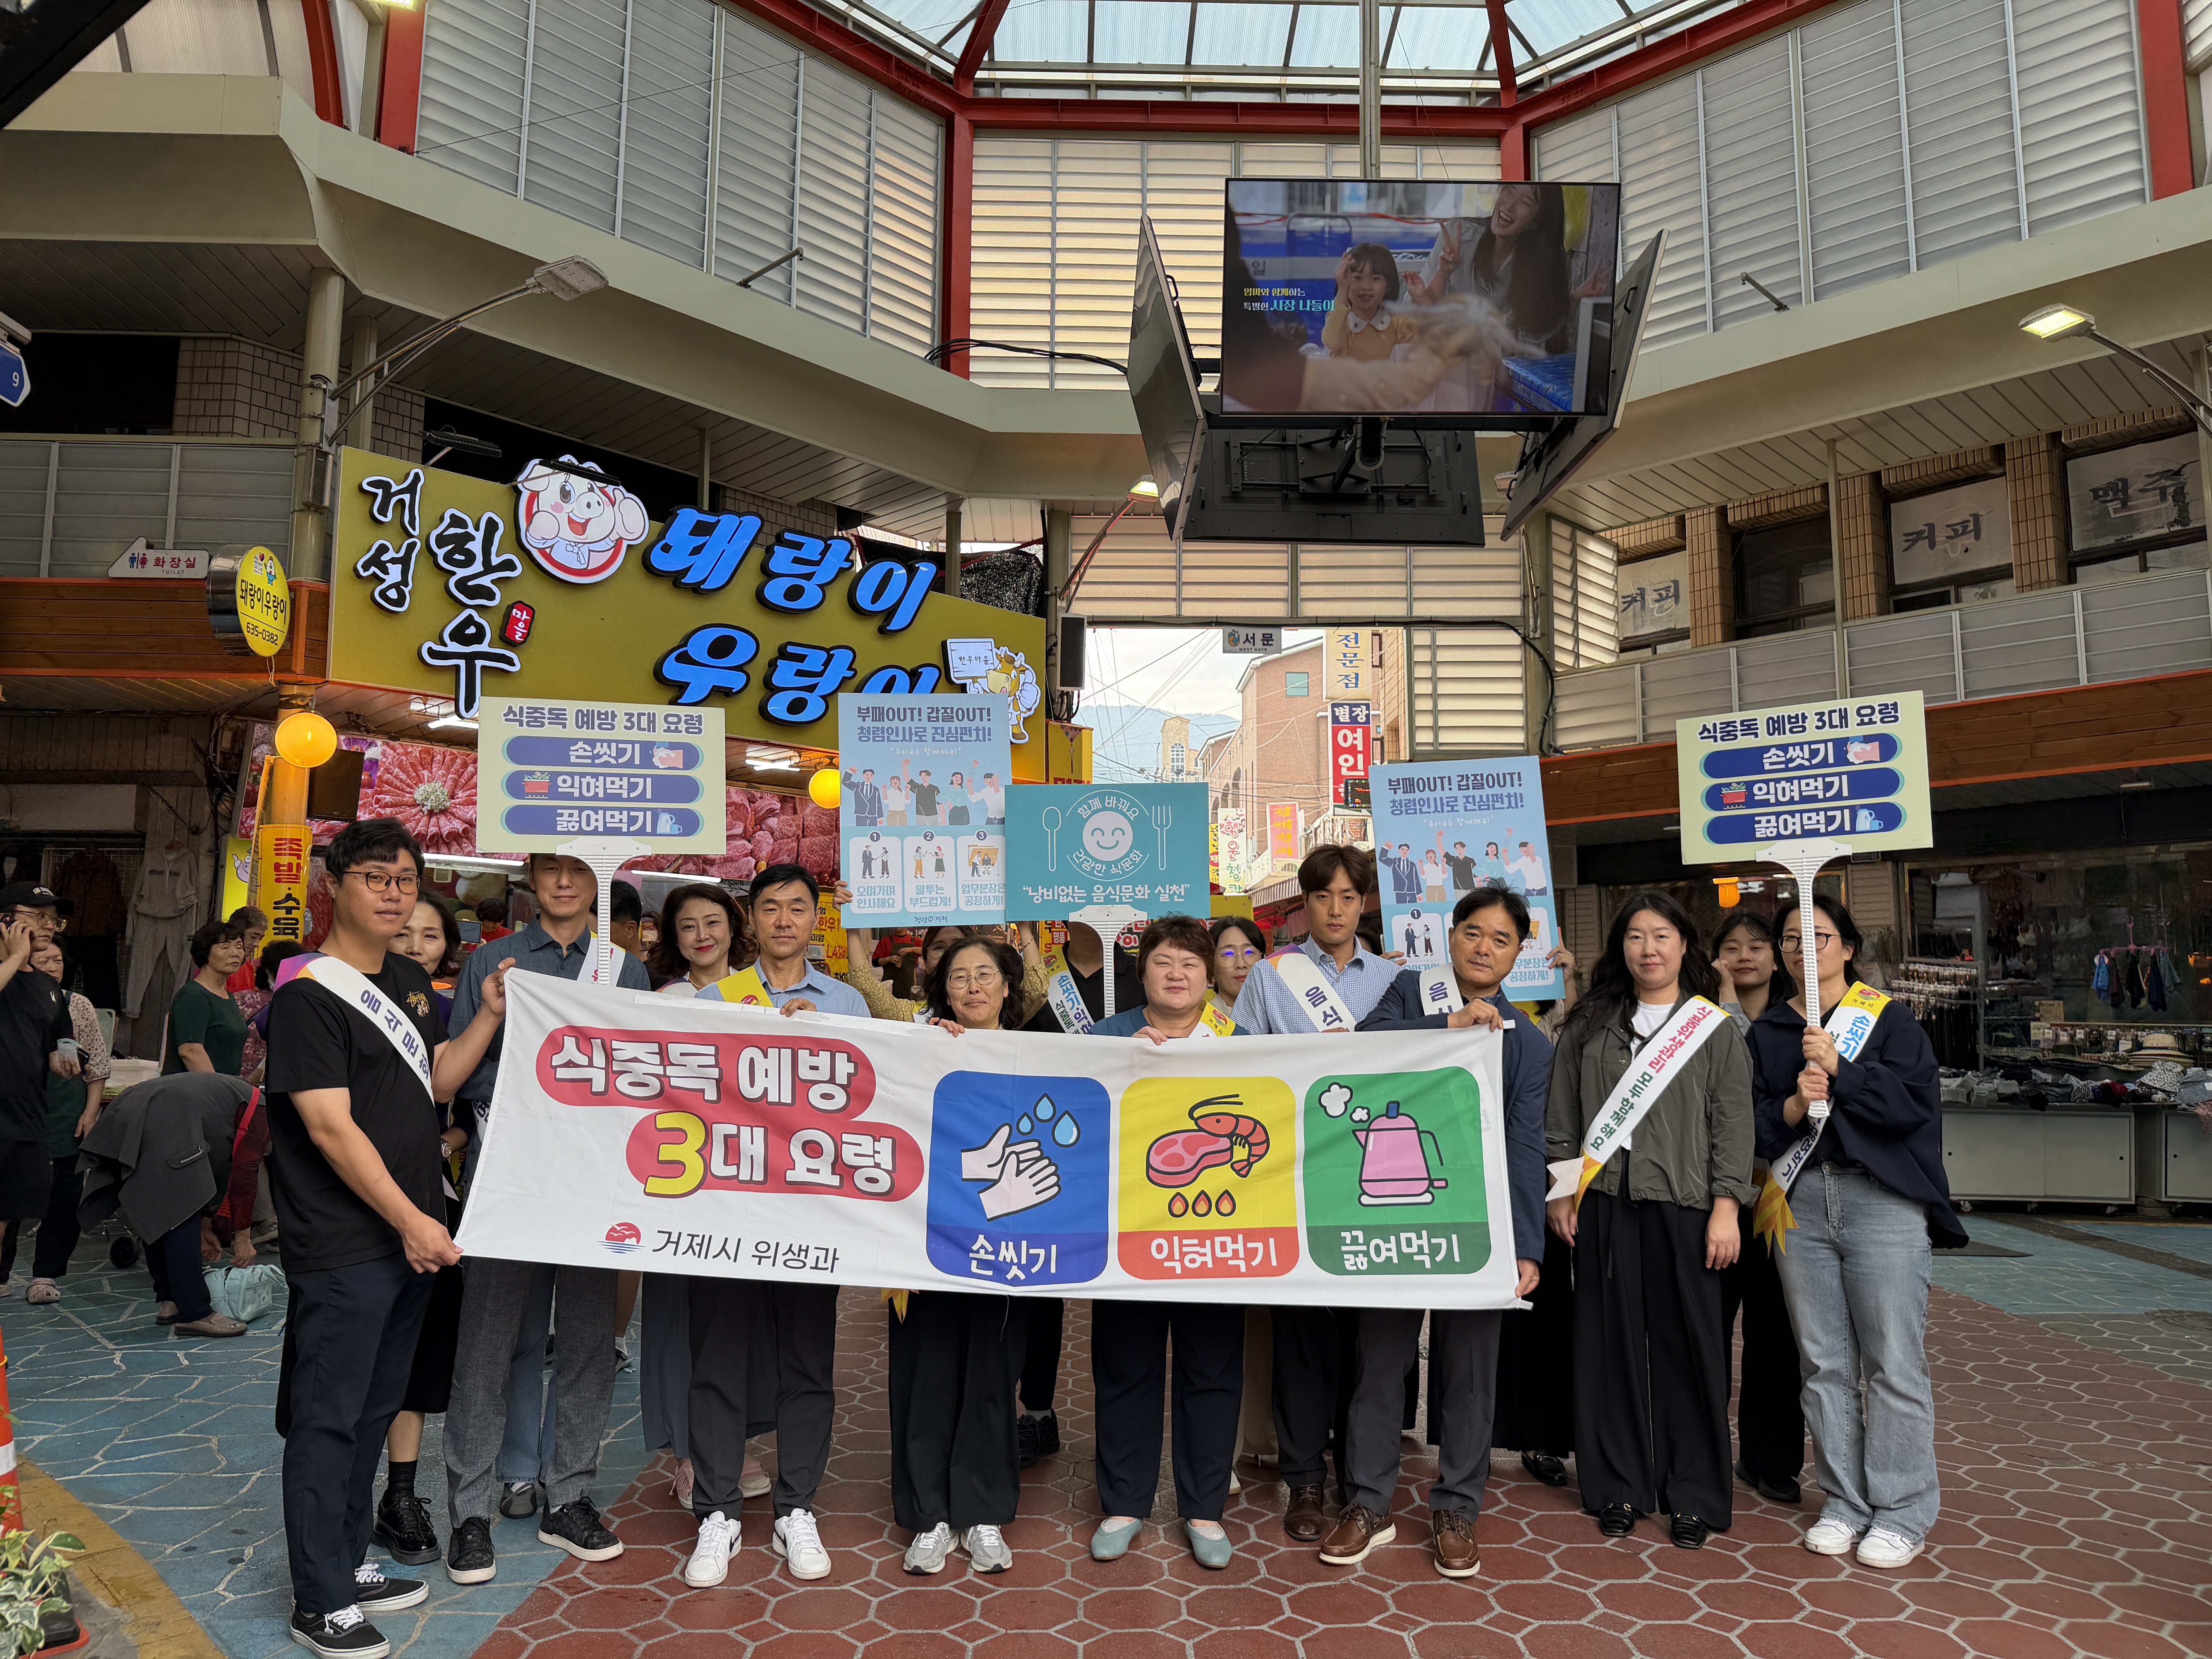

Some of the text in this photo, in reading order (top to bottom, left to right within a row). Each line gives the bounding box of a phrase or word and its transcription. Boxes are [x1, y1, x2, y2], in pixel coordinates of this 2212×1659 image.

[1243, 288, 1305, 296] 엄마와 함께하는
[1243, 299, 1336, 311] 특별한 시장 나들이
[12, 372, 19, 387] 9
[1902, 513, 1984, 553] 커피
[153, 556, 196, 568] 화장실
[644, 506, 939, 634] 돼랑이
[240, 579, 287, 625] 돼랑이우랑이
[1621, 579, 1680, 613] 커피
[422, 508, 522, 718] 한우
[512, 608, 531, 641] 마을
[246, 622, 278, 646] 635-0382
[1243, 633, 1274, 646] 서문
[958, 656, 990, 665] 한우마을
[1336, 632, 1364, 689] 전문점
[503, 705, 704, 735] 식중독 예방 3대 요령
[857, 706, 991, 722] 부패OUT! 갑질OUT!
[1334, 705, 1369, 723] 별장
[1698, 701, 1899, 743] 식중독 예방 3대 요령
[857, 726, 992, 742] 청렴인사로 진심펀치!
[569, 741, 641, 764] 손씻기
[1337, 728, 1365, 797] 여인
[1762, 742, 1834, 770] 손씻기
[556, 775, 652, 799] 익혀먹기
[1388, 771, 1523, 795] 부패OUT! 갑질OUT!
[1753, 775, 1849, 804] 익혀먹기
[1077, 795, 1140, 821] 함께 바꿔요
[1389, 792, 1525, 816] 청렴인사로 진심펀치!
[556, 809, 652, 833] 끓여먹기
[1754, 809, 1850, 838] 끓여먹기
[1072, 848, 1144, 877] 건강한 식문화
[857, 885, 895, 897] 오며가며
[916, 884, 945, 895] 말투는
[962, 883, 1006, 894] 업무분장은
[1091, 884, 1151, 903] 음식문화
[857, 898, 896, 909] 인사해요
[910, 896, 951, 907] 부드럽게!
[964, 895, 1004, 907] 공정하게!
[1515, 957, 1549, 969] 무분장은
[1510, 970, 1549, 982] 공정하게!
[1648, 1006, 1713, 1074] 식품위생관리
[550, 1034, 859, 1114] 식중독 예방
[1628, 1071, 1654, 1099] 모두
[644, 1110, 897, 1199] 3대 요령
[652, 1229, 840, 1274] 거제시 위생과
[968, 1234, 1058, 1281] 손씻기
[1150, 1234, 1279, 1274] 익혀먹기
[1340, 1230, 1462, 1272] 끓여먹기
